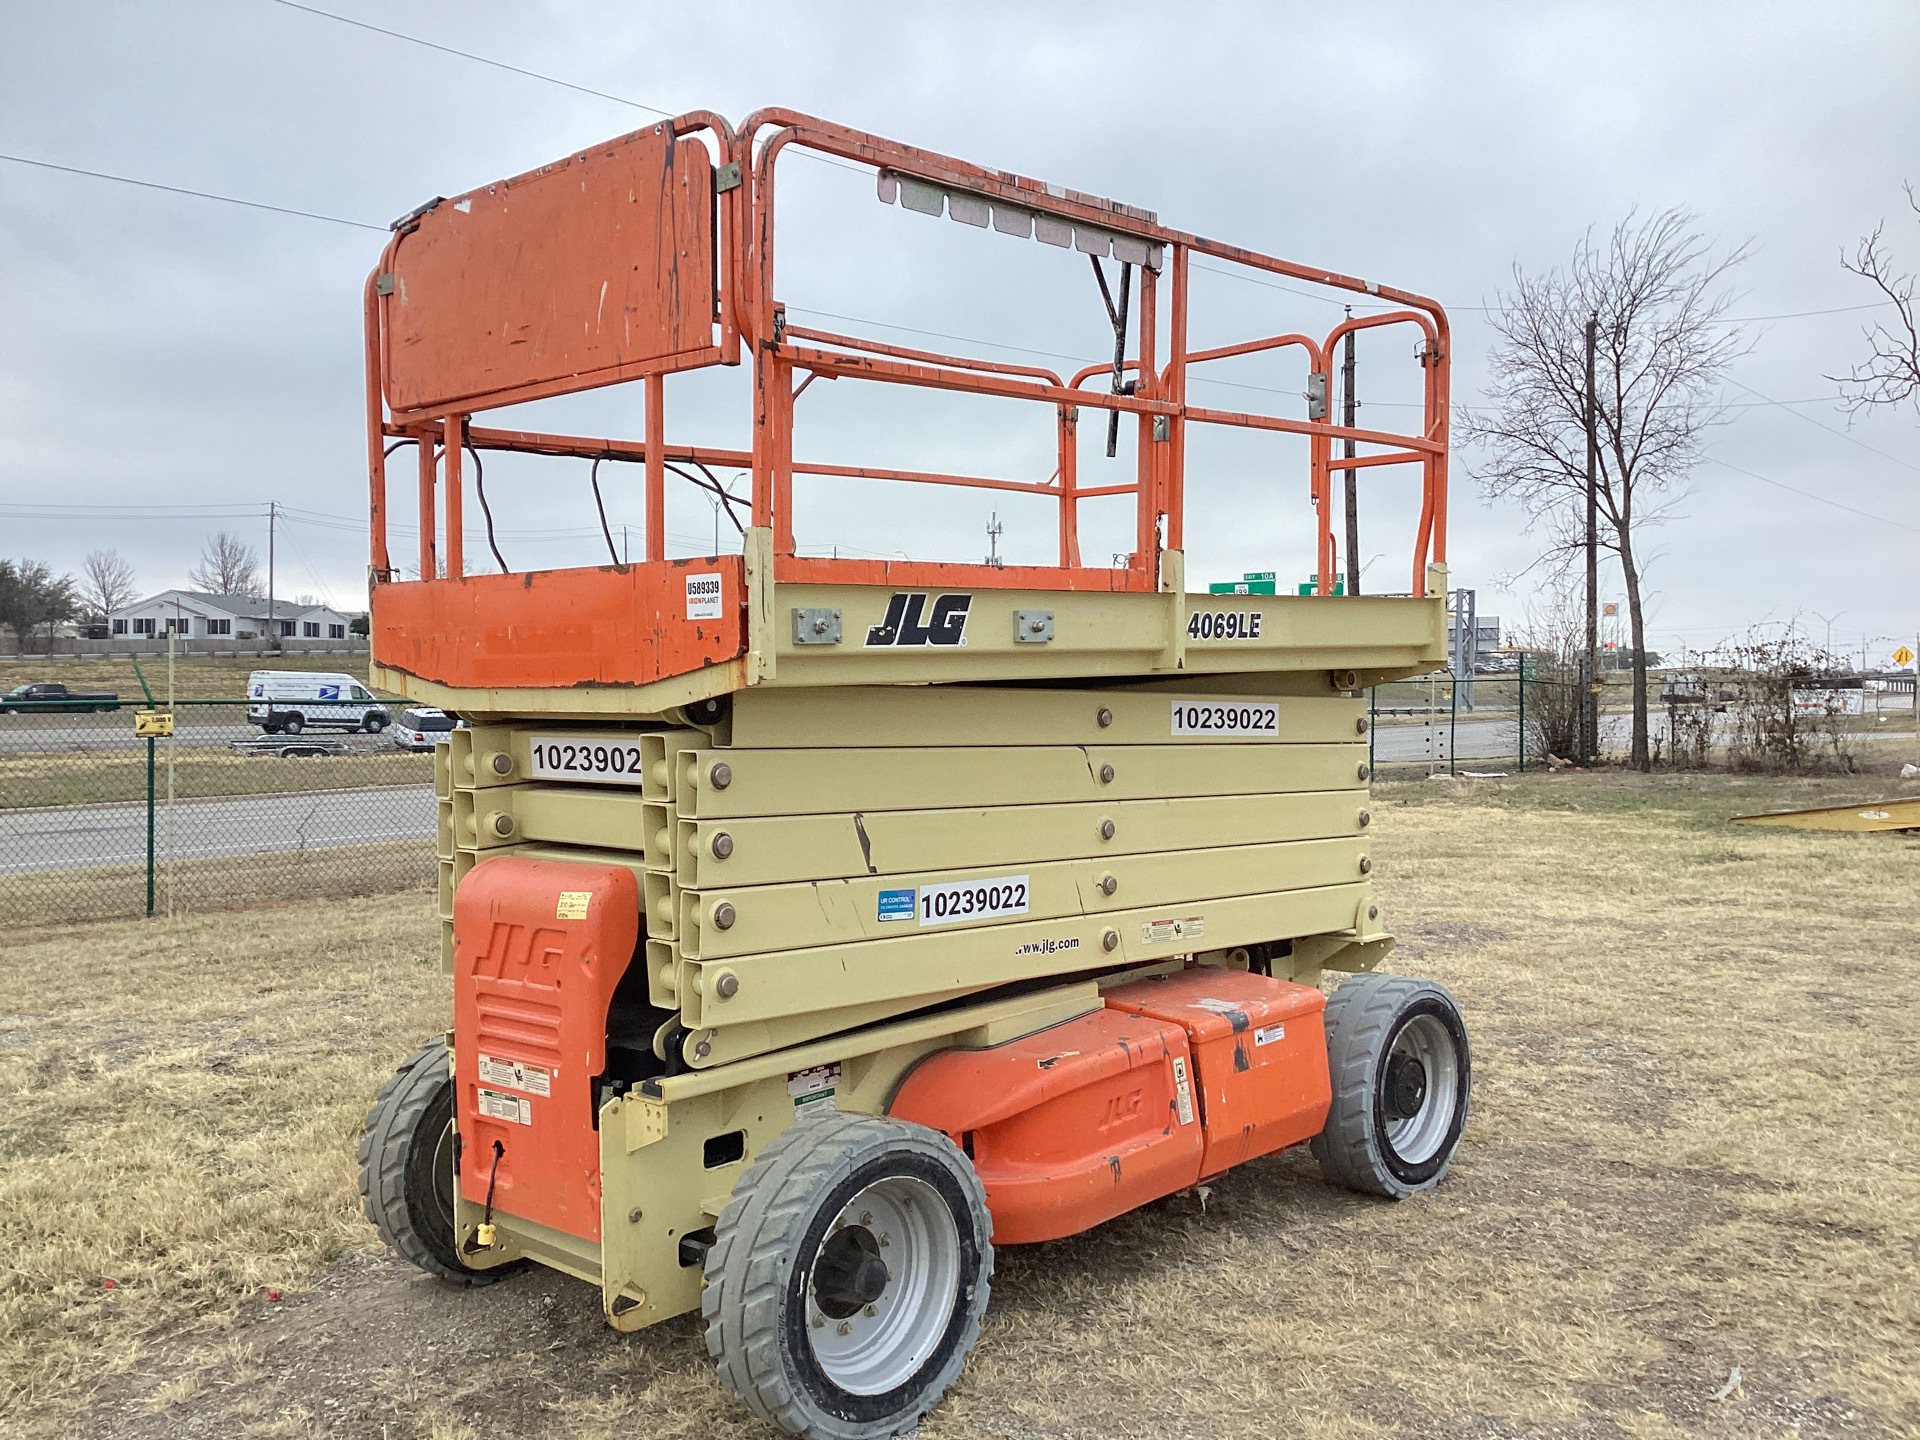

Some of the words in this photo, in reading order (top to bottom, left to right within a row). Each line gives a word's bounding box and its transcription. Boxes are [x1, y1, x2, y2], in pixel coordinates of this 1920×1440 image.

[687, 580, 720, 595] U589339
[864, 592, 973, 647] JLG
[1187, 612, 1262, 639] 4069LE
[1173, 706, 1276, 730] 10239022
[533, 744, 642, 774] 1023902
[921, 883, 1026, 919] 10239022
[472, 922, 567, 991] JLG
[1015, 938, 1080, 955] ww.jlg.com
[1098, 1088, 1143, 1131] JLG
